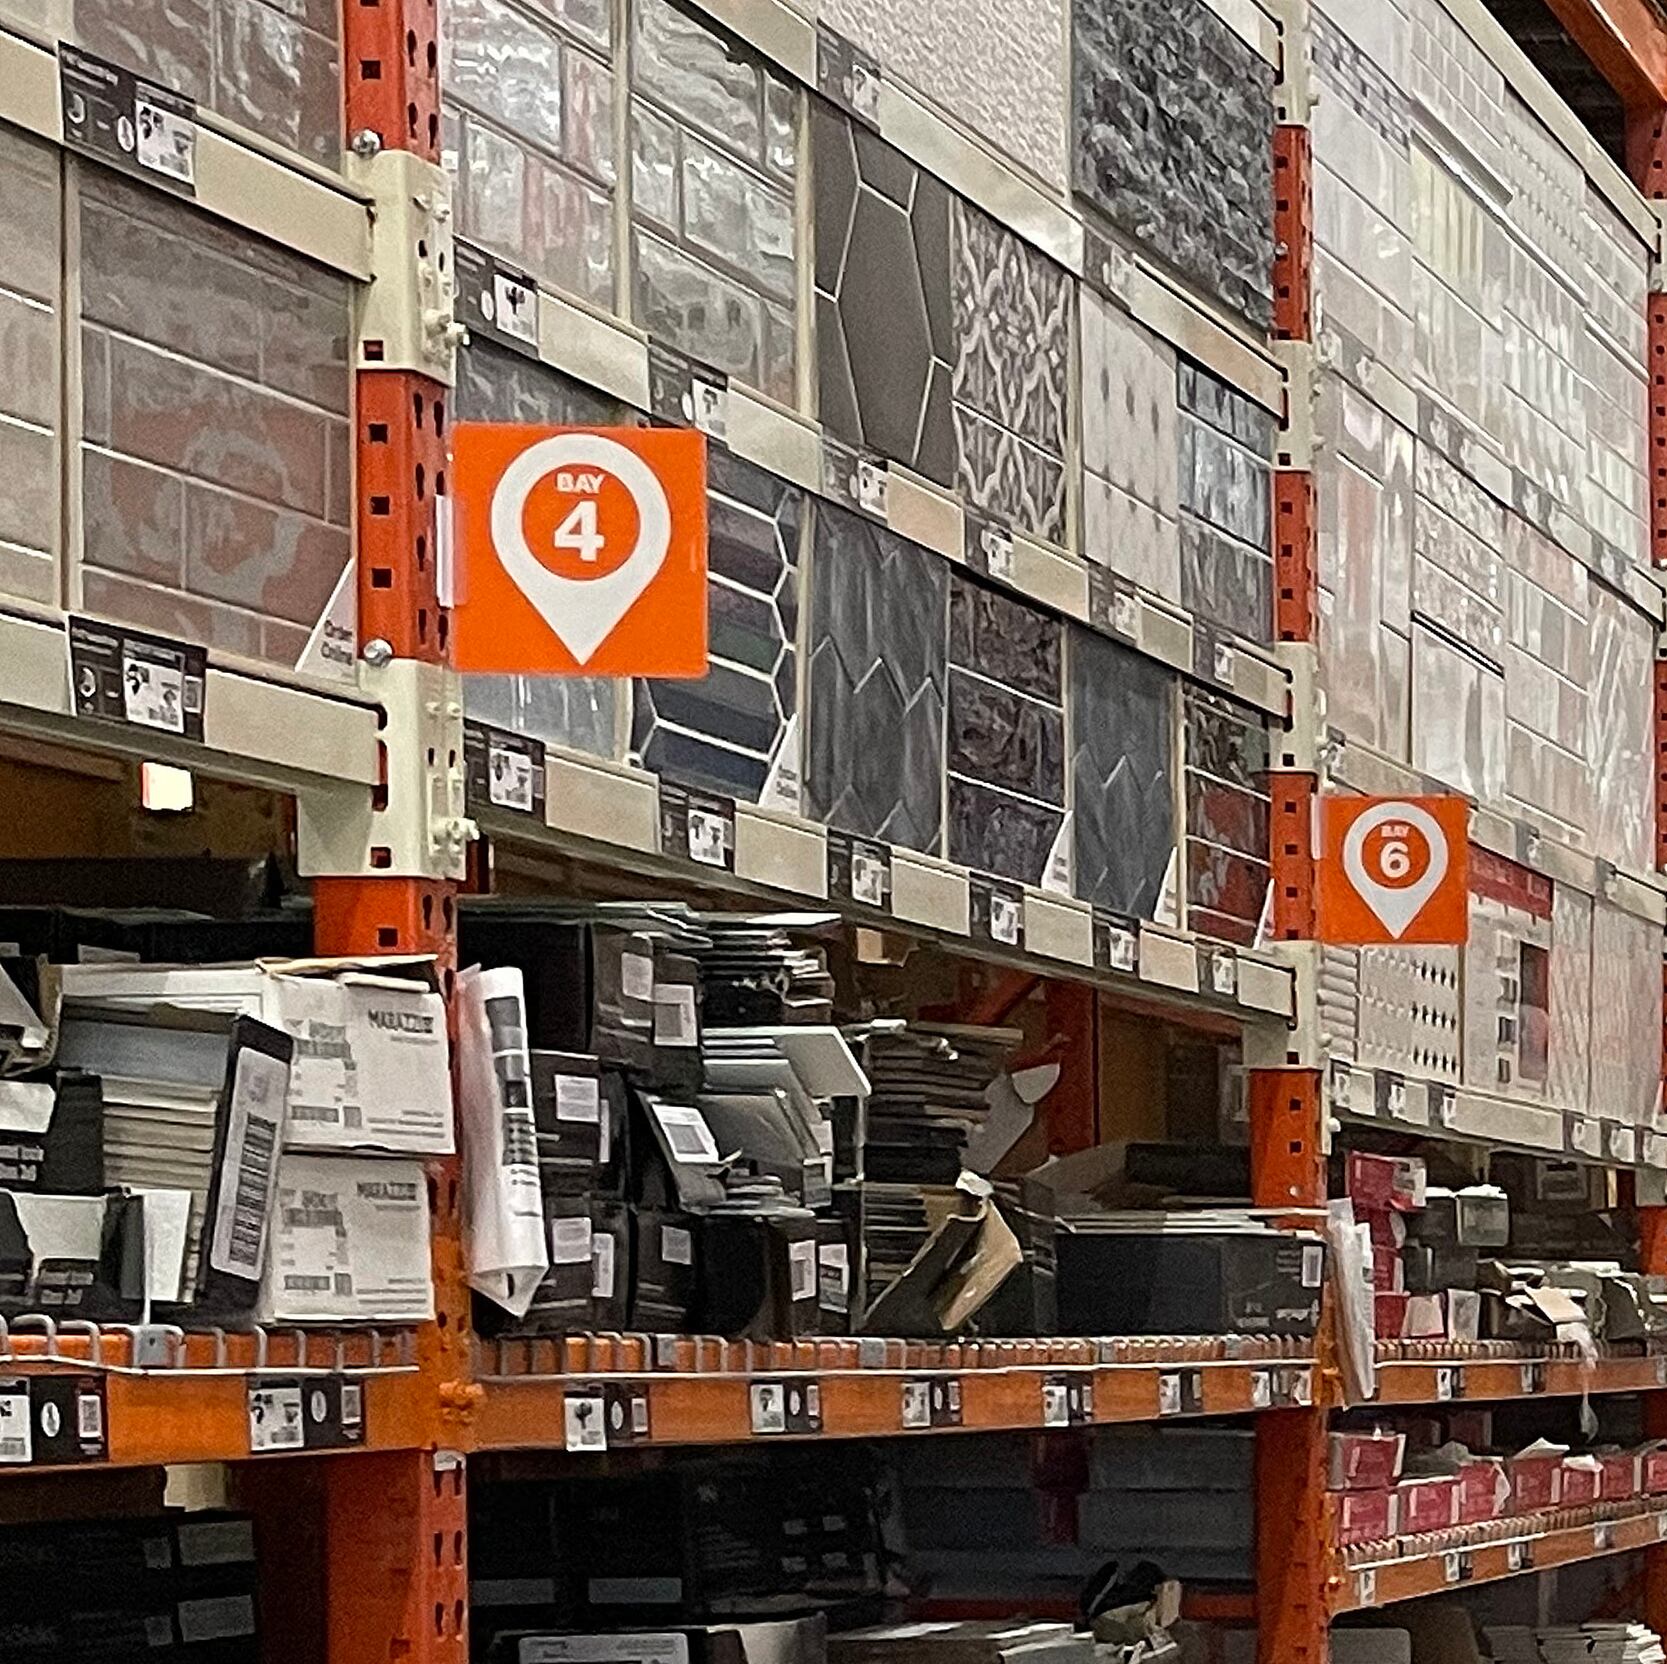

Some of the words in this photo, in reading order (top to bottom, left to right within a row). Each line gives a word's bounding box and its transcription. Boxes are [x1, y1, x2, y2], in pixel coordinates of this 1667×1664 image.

[556, 472, 605, 495] BAY
[553, 500, 606, 562] 4
[1380, 825, 1411, 838] BAY
[1379, 841, 1411, 879] 6
